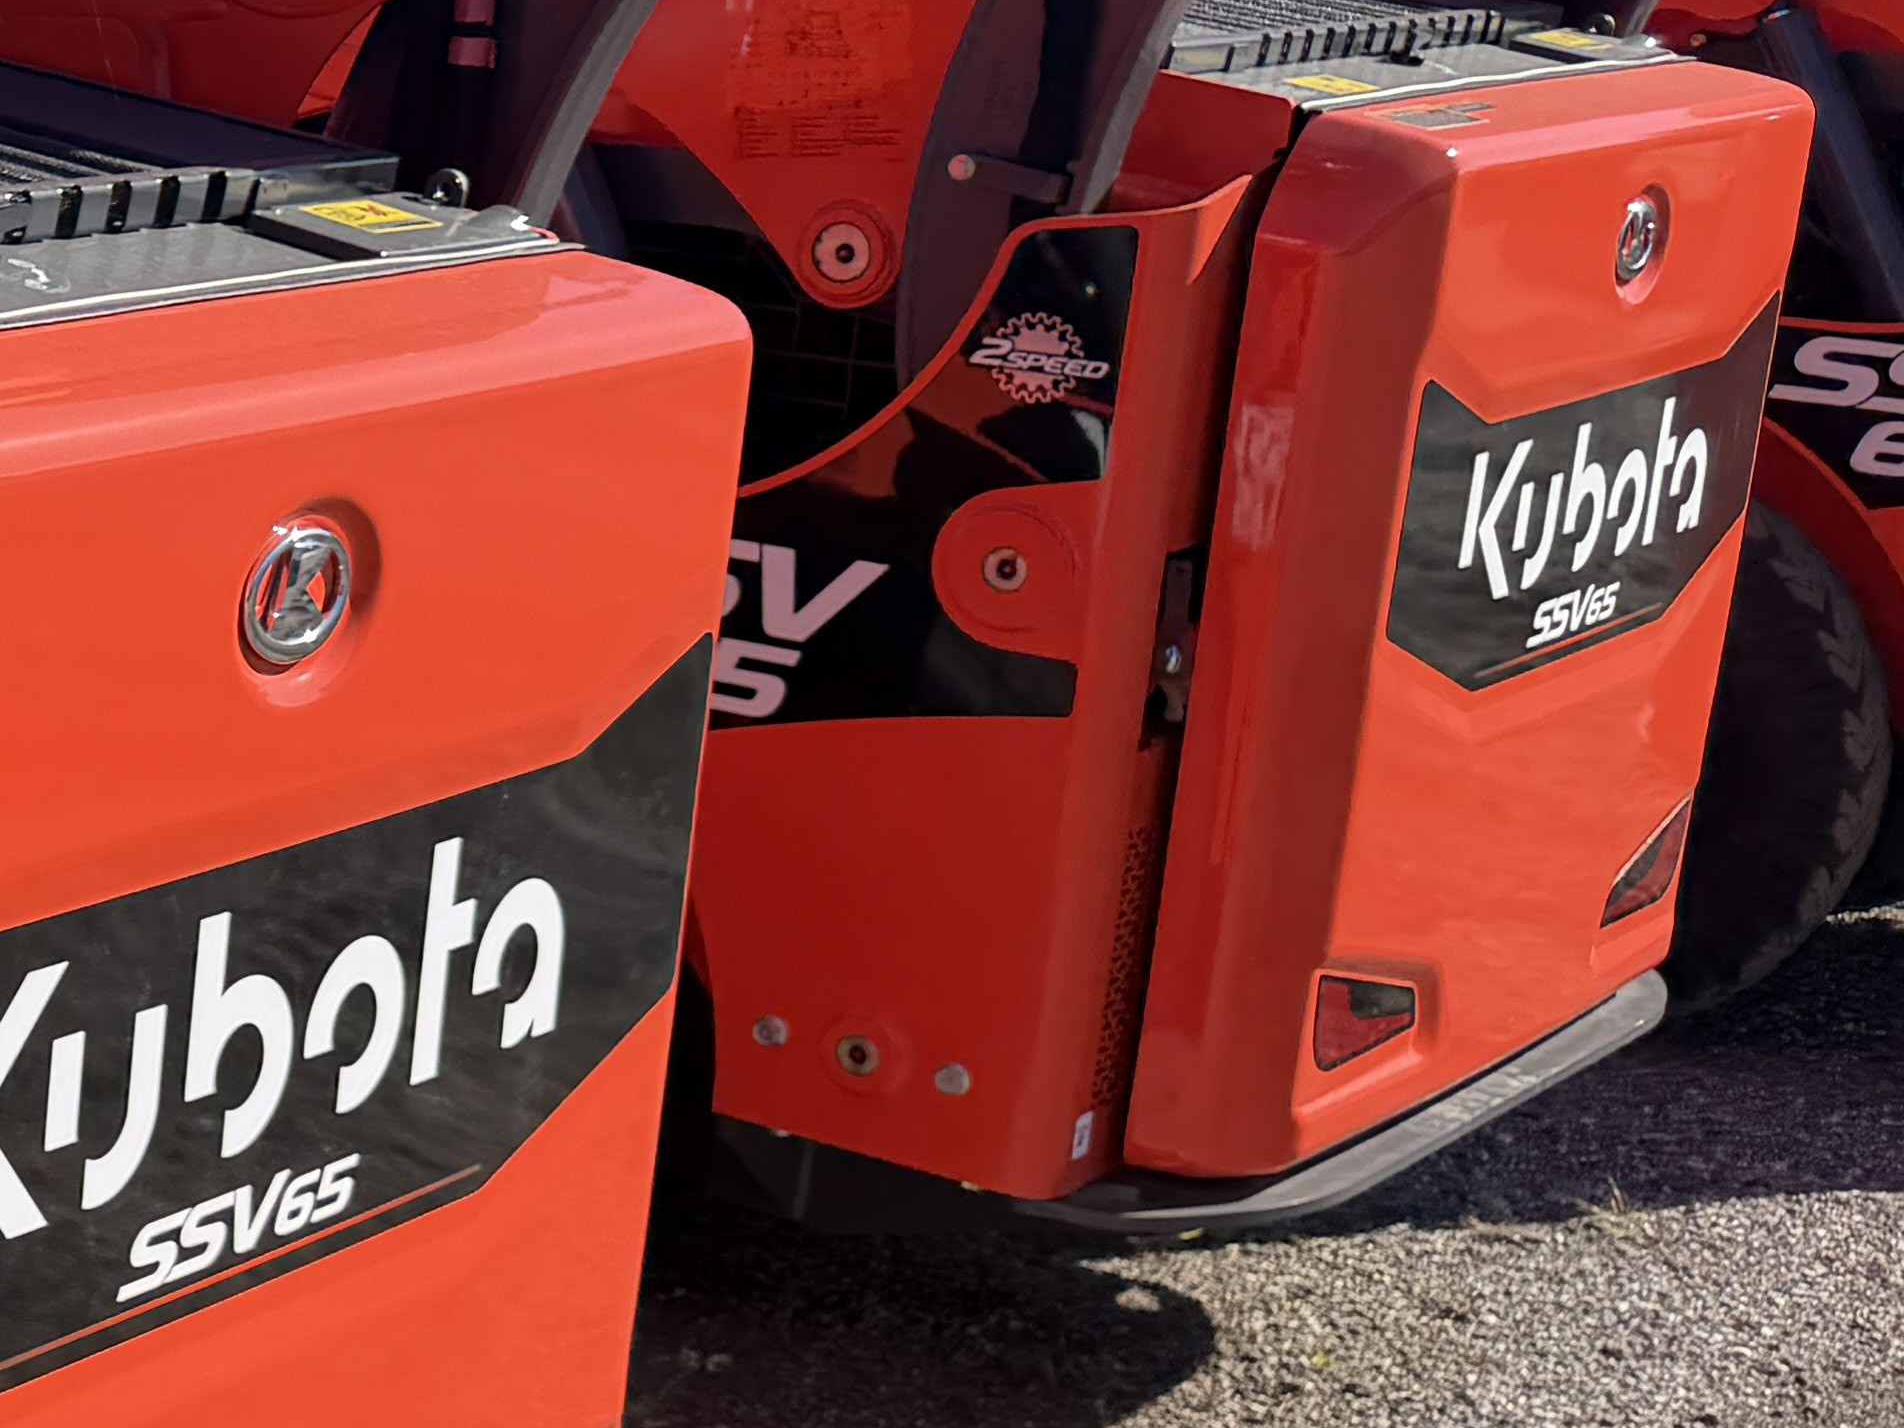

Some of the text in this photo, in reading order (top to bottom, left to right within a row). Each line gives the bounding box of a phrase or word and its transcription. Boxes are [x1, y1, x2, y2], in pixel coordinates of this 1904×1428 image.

[1768, 335, 1904, 415] S
[1458, 396, 1708, 600] Kubota
[1525, 581, 1621, 649] SSV65
[115, 1152, 360, 1302] SSV65
